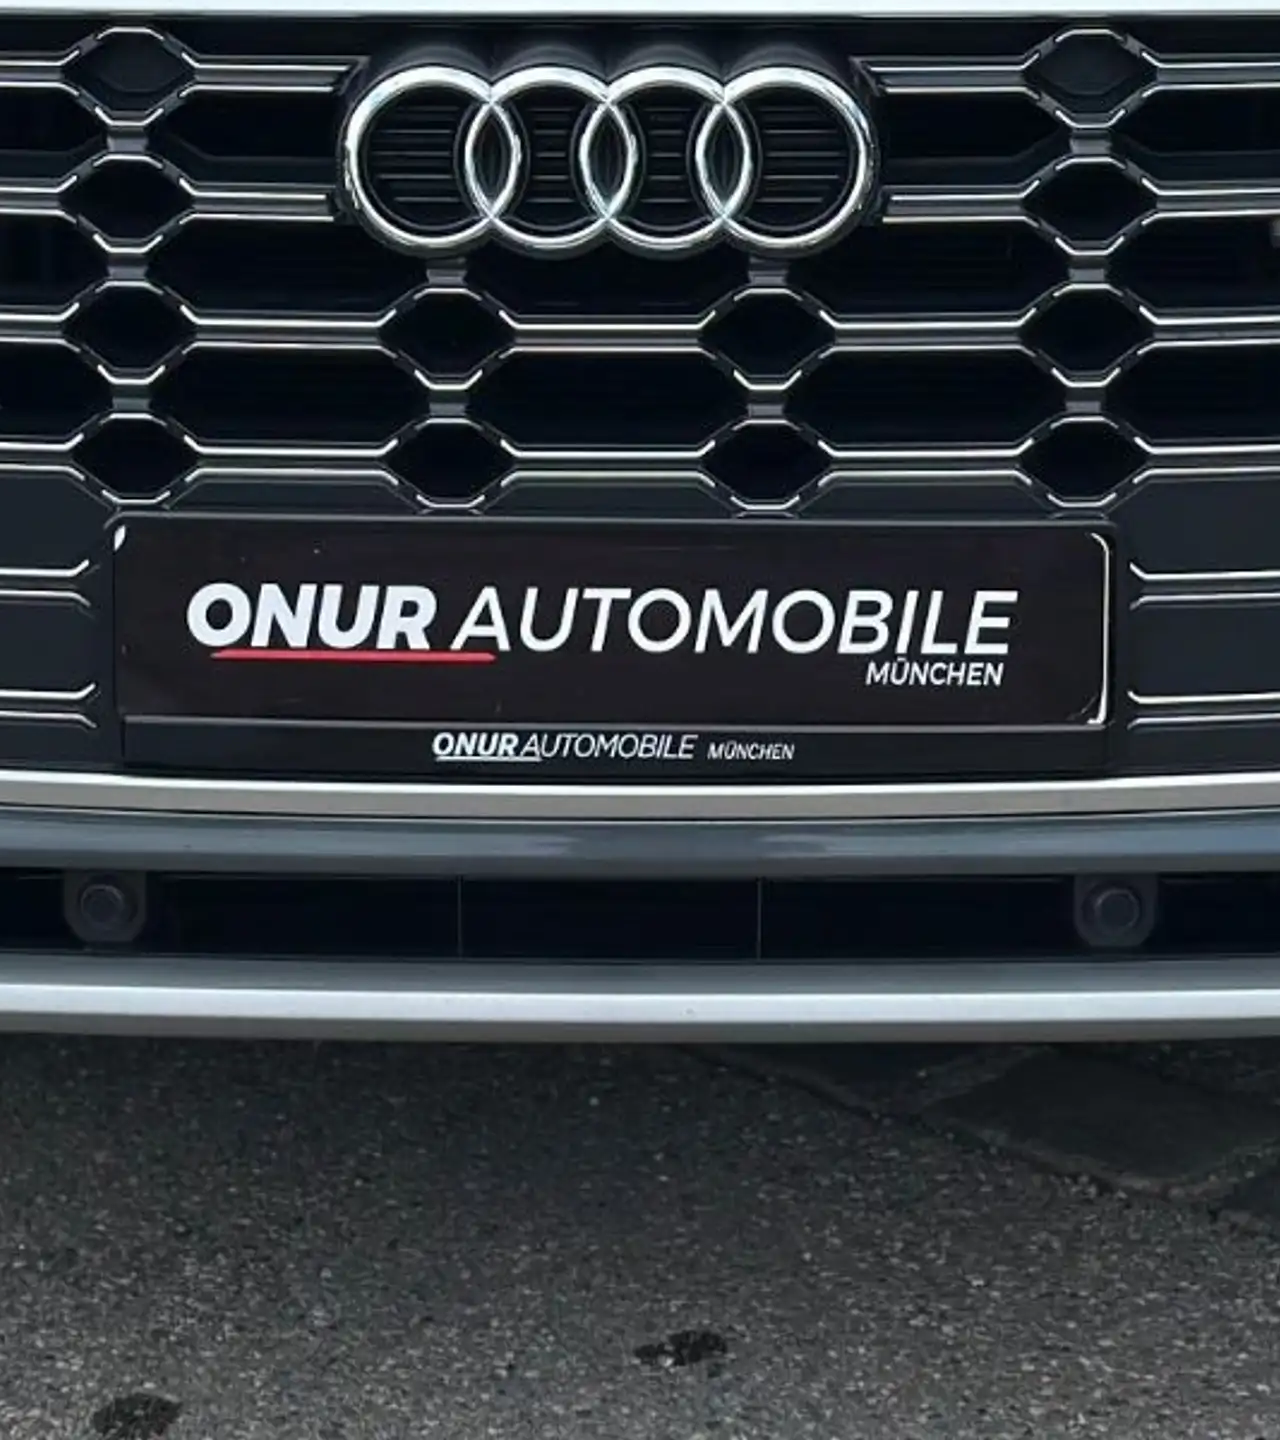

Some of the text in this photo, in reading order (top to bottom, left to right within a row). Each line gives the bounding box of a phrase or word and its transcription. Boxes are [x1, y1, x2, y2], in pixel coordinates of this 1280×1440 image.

[187, 582, 1018, 655] ONUR AUTOMOBILE
[865, 656, 1005, 686] MÜNCHEN
[707, 740, 796, 762] MÜNCHEN
